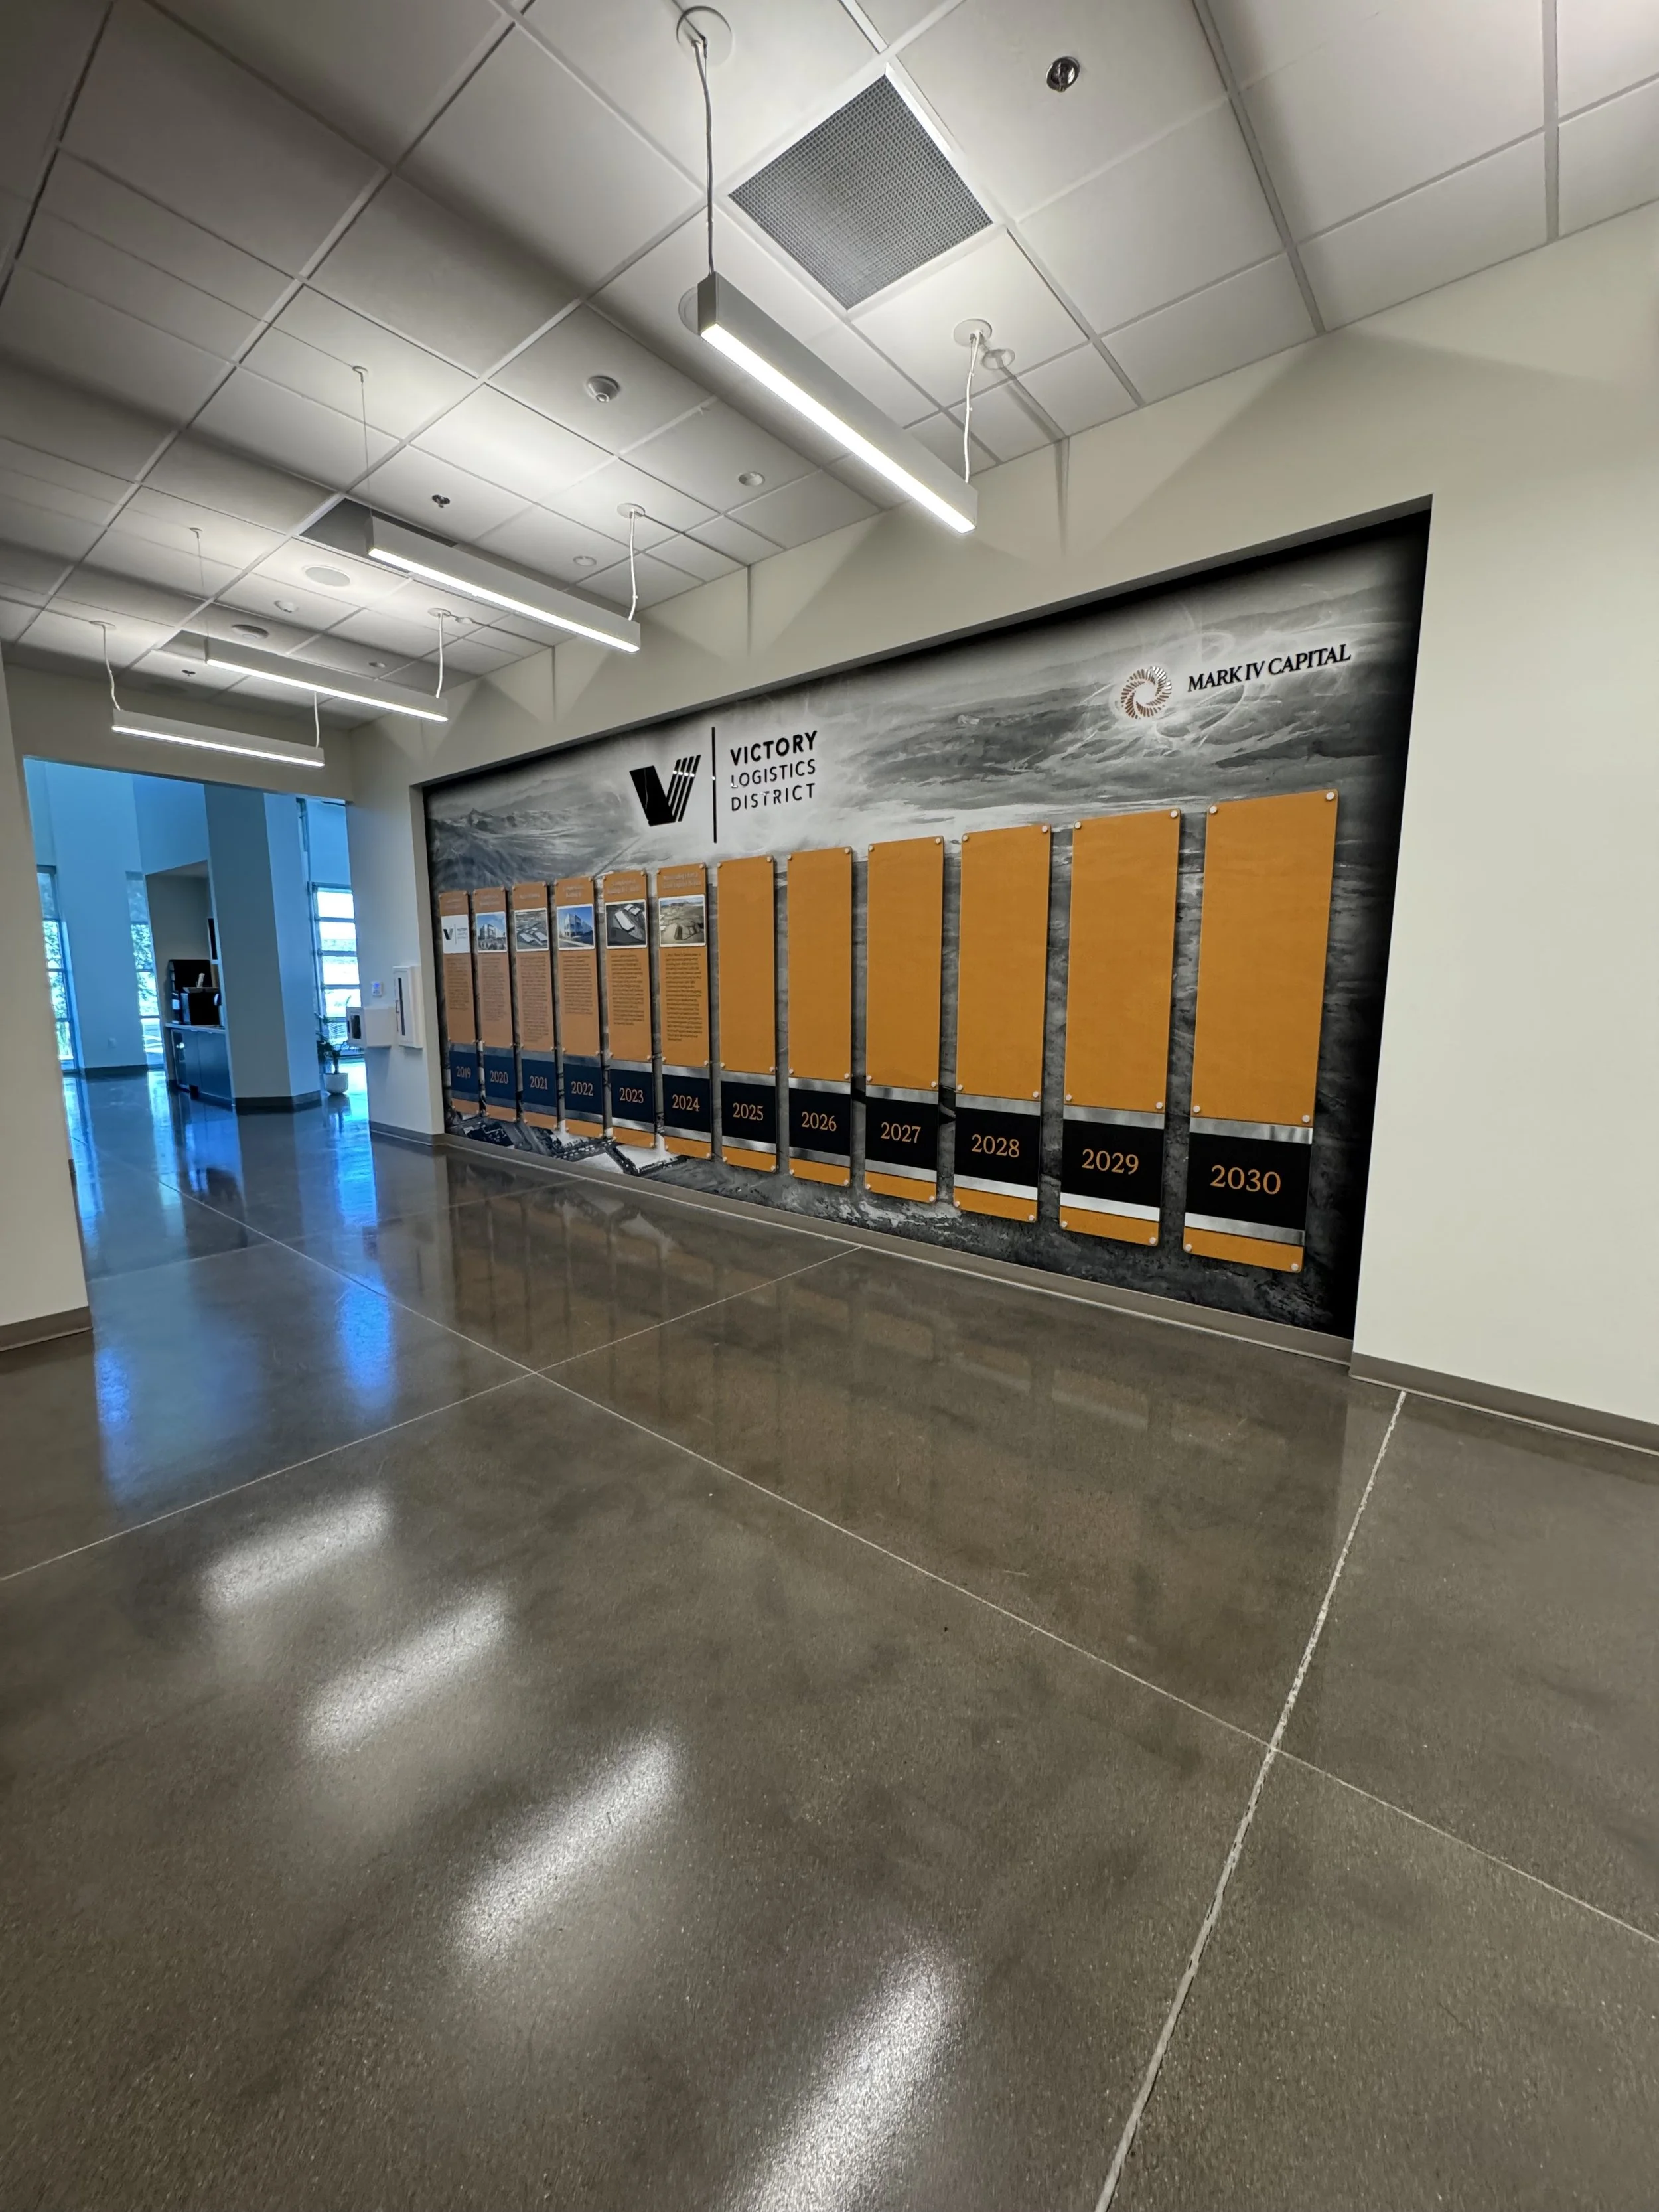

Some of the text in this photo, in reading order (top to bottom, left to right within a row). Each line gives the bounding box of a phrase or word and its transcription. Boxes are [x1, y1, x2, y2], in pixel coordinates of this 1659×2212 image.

[1188, 644, 1352, 692] MARK IV CAPITAL
[730, 730, 818, 766] VICTORY
[731, 759, 816, 788] LOGISTICS
[731, 783, 815, 811] DISTRICT
[456, 1065, 472, 1079] 2019
[490, 1070, 509, 1084] 2020
[530, 1075, 548, 1090] 2021
[571, 1080, 594, 1096] 2022
[619, 1087, 644, 1104] 2023
[672, 1094, 701, 1112] 2024
[732, 1102, 764, 1121] 2025
[801, 1111, 837, 1132] 2026
[880, 1122, 922, 1143] 2027
[971, 1134, 1020, 1158] 2028
[1081, 1148, 1139, 1175] 2029
[1210, 1164, 1281, 1195] 2030
